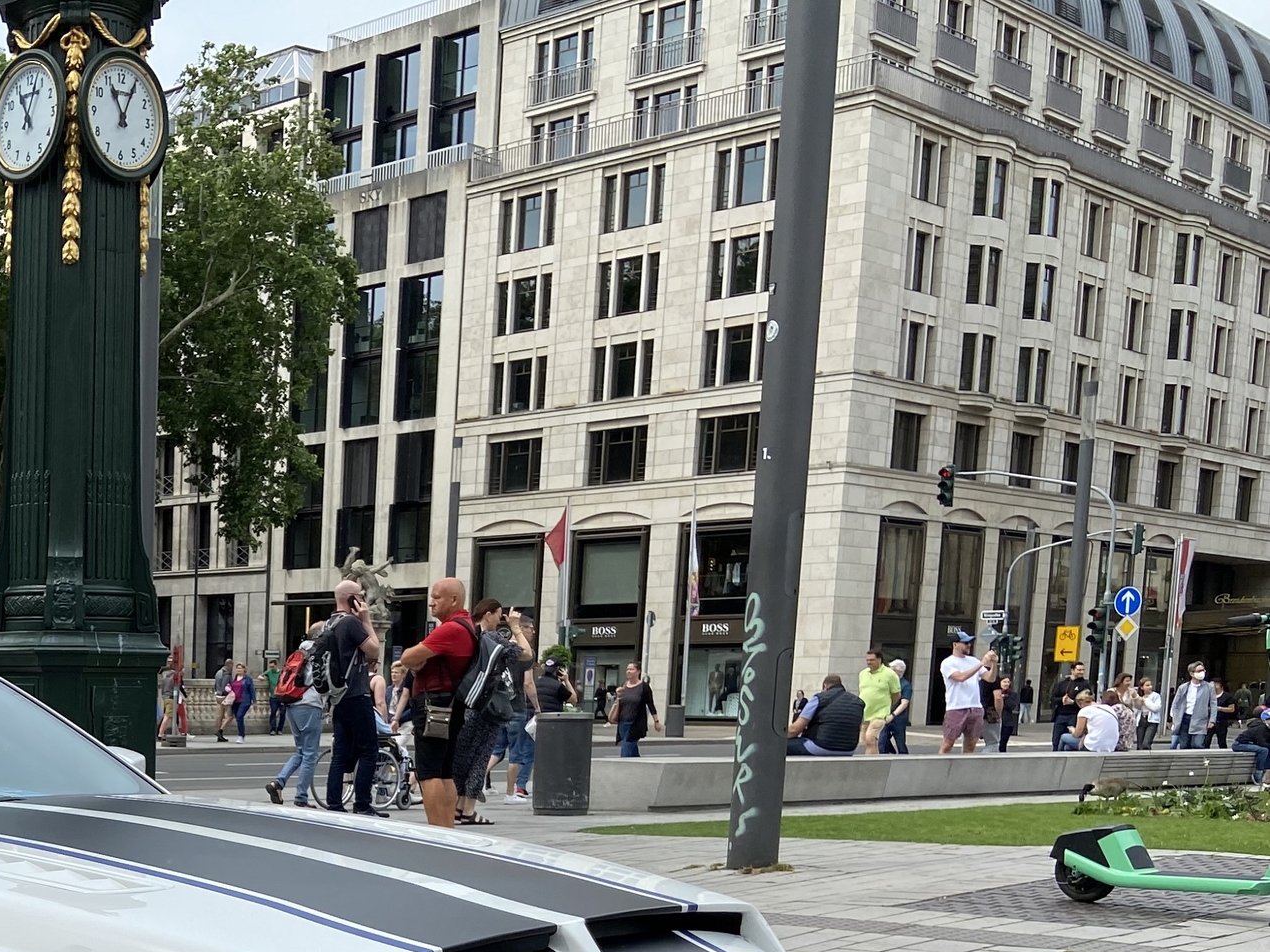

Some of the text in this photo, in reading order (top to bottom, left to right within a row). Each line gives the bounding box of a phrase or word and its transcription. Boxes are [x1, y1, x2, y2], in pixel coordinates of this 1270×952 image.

[27, 75, 34, 86] 12
[105, 75, 112, 86] 11
[118, 73, 126, 84] 12
[48, 88, 52, 99] 2
[95, 87, 103, 98] 10
[7, 100, 14, 112] 10
[142, 99, 147, 109] 2
[51, 106, 55, 117] 3
[92, 105, 96, 116] 9
[4, 121, 9, 132] 9
[145, 118, 150, 129] 3
[95, 126, 100, 136] 8
[7, 140, 11, 150] 8
[105, 142, 110, 152] 7
[140, 137, 145, 147] 4
[38, 143, 42, 153] 5
[131, 148, 136, 158] 5
[15, 150, 20, 161] 7
[26, 152, 30, 162] 6
[118, 150, 123, 160] 6
[592, 626, 616, 635] BOSS
[702, 623, 729, 632] BOSS
